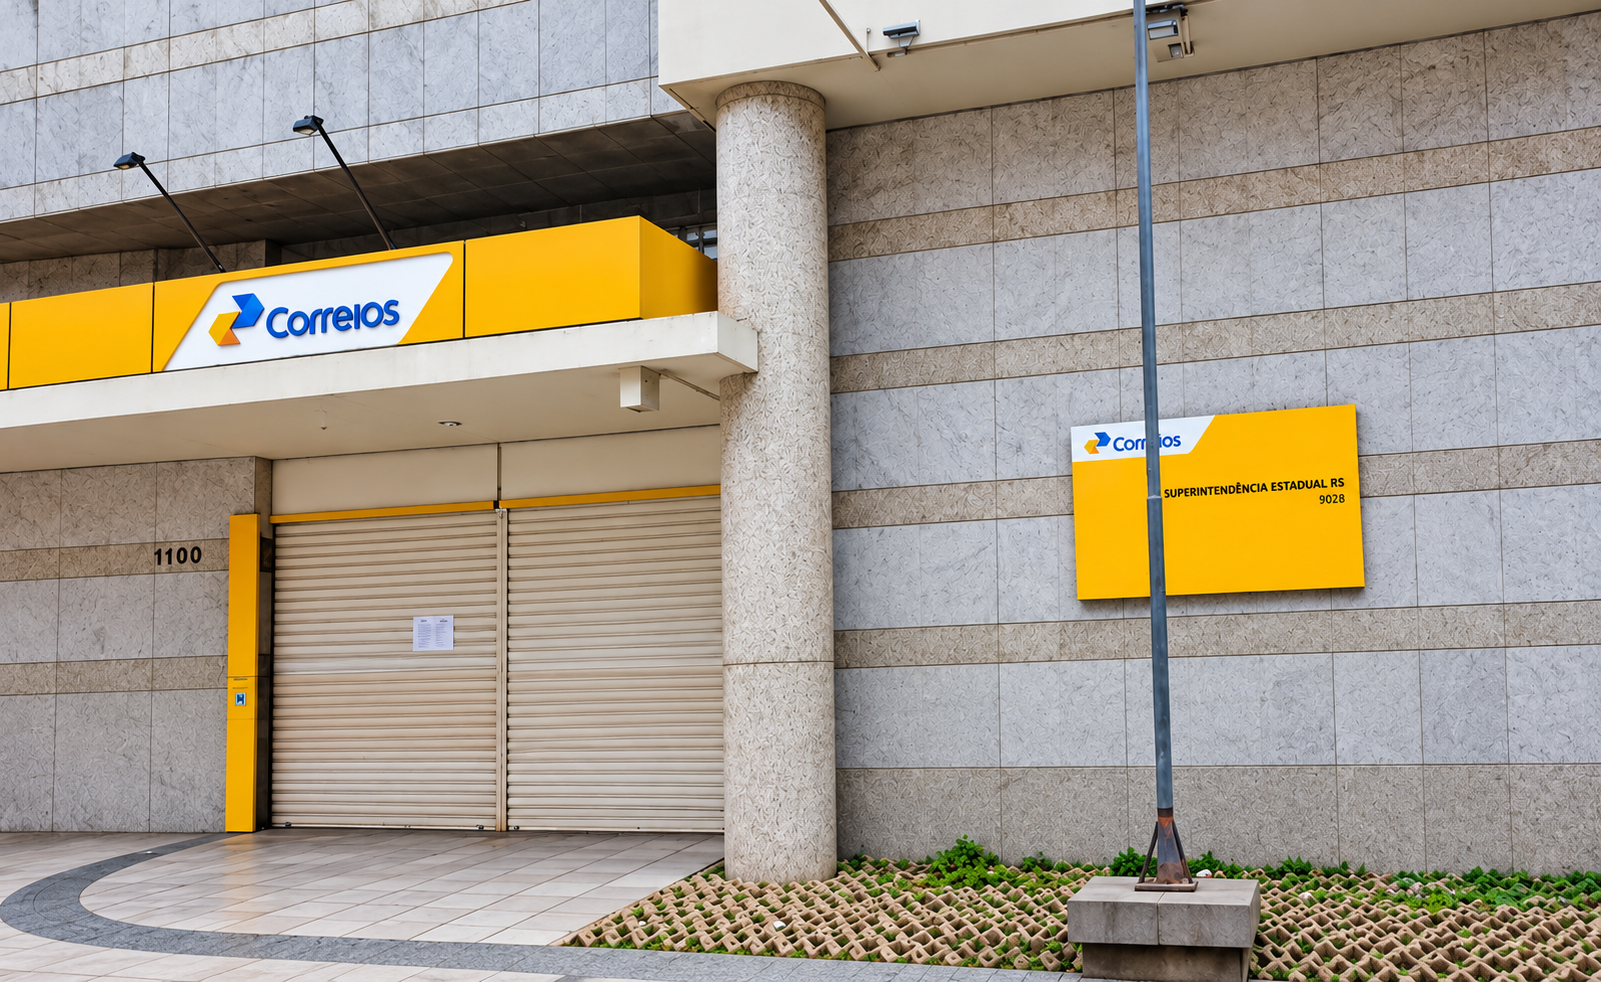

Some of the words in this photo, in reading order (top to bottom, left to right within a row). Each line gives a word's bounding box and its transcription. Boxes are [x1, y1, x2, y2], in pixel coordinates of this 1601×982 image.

[266, 299, 400, 339] Correios
[1113, 434, 1181, 452] Corrios
[1164, 482, 1268, 498] SUPERINTENDÊNCIA
[1271, 479, 1327, 491] ESTADUAL
[1331, 477, 1345, 488] RS
[1319, 494, 1345, 505] 9028
[154, 546, 202, 566] 1100
